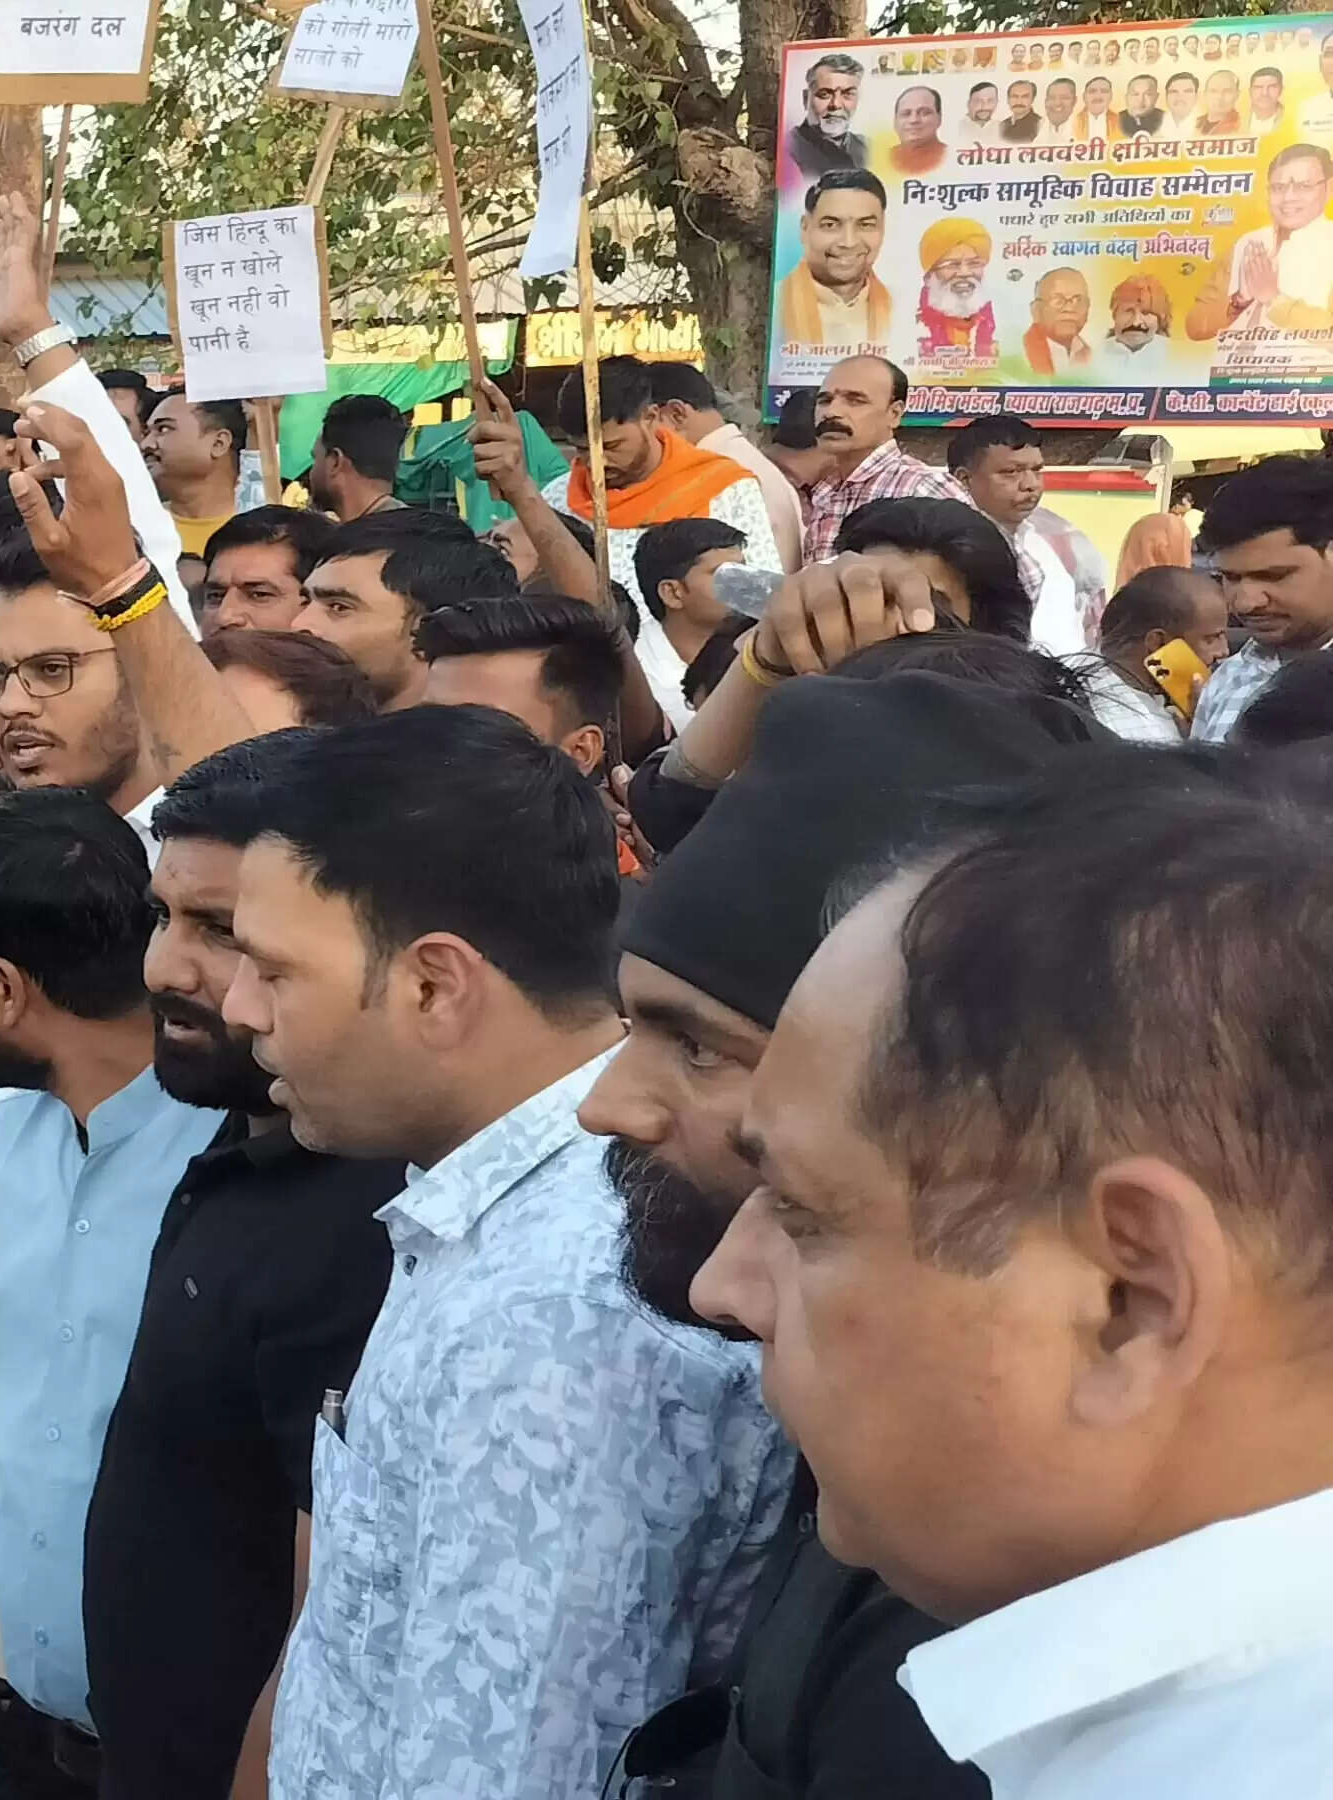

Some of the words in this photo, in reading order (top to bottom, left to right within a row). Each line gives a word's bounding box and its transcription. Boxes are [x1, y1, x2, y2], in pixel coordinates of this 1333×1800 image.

[20, 9, 81, 37] बजरंग
[91, 16, 126, 37] दल
[376, 18, 413, 40] मारो
[956, 144, 1012, 167] लोधा
[1185, 135, 1258, 159] समाज
[996, 175, 1083, 208] सामूहिक
[1090, 172, 1155, 200] विवाह
[1161, 168, 1254, 197] सम्मेलन
[183, 221, 222, 247] जिस
[226, 216, 270, 246] हिन्दू
[274, 216, 298, 235] का
[183, 262, 216, 288] खून
[221, 260, 236, 278] न
[189, 296, 222, 323] खून
[266, 284, 291, 308] वो
[188, 326, 231, 352] पानी
[235, 324, 251, 353] है
